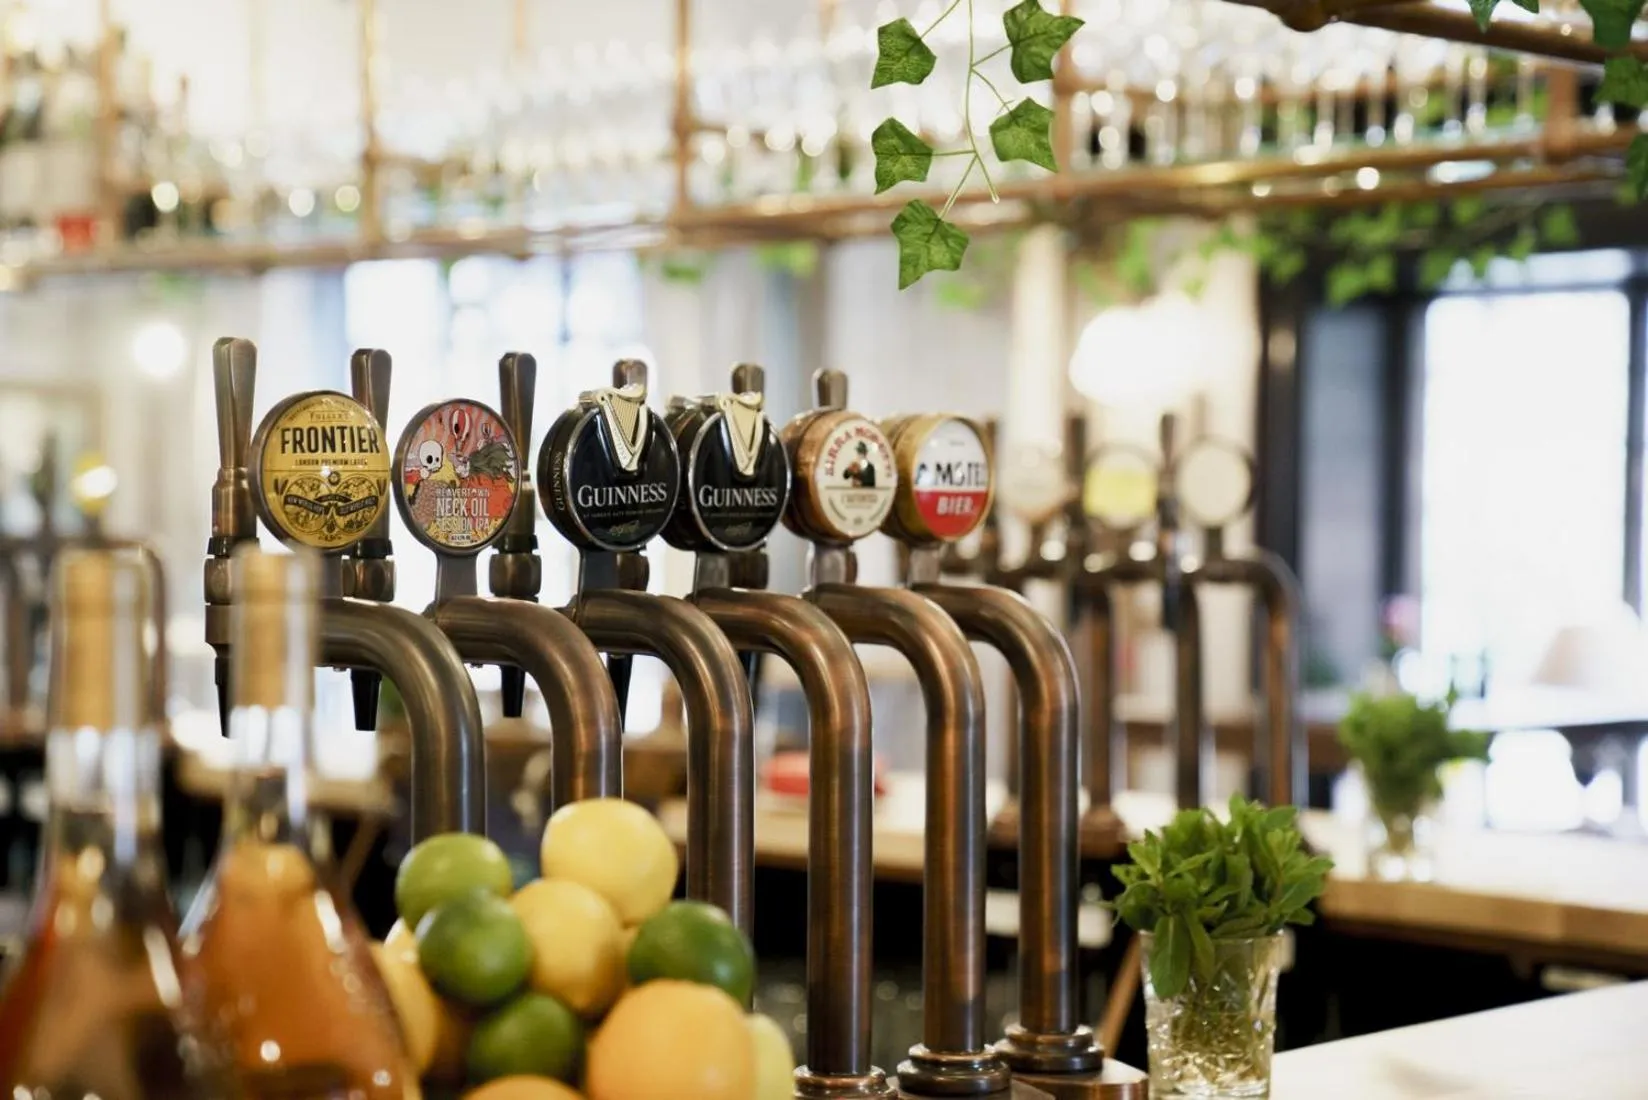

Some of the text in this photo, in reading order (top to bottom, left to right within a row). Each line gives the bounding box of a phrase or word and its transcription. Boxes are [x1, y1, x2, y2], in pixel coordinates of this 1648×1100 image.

[280, 425, 380, 455] FRONTIER
[577, 482, 668, 508] GUINNESS
[698, 484, 778, 508] GUINNESS
[936, 495, 974, 516] BIER
[436, 498, 490, 517] NECK OIL
[436, 516, 490, 531] SESSION IPA
